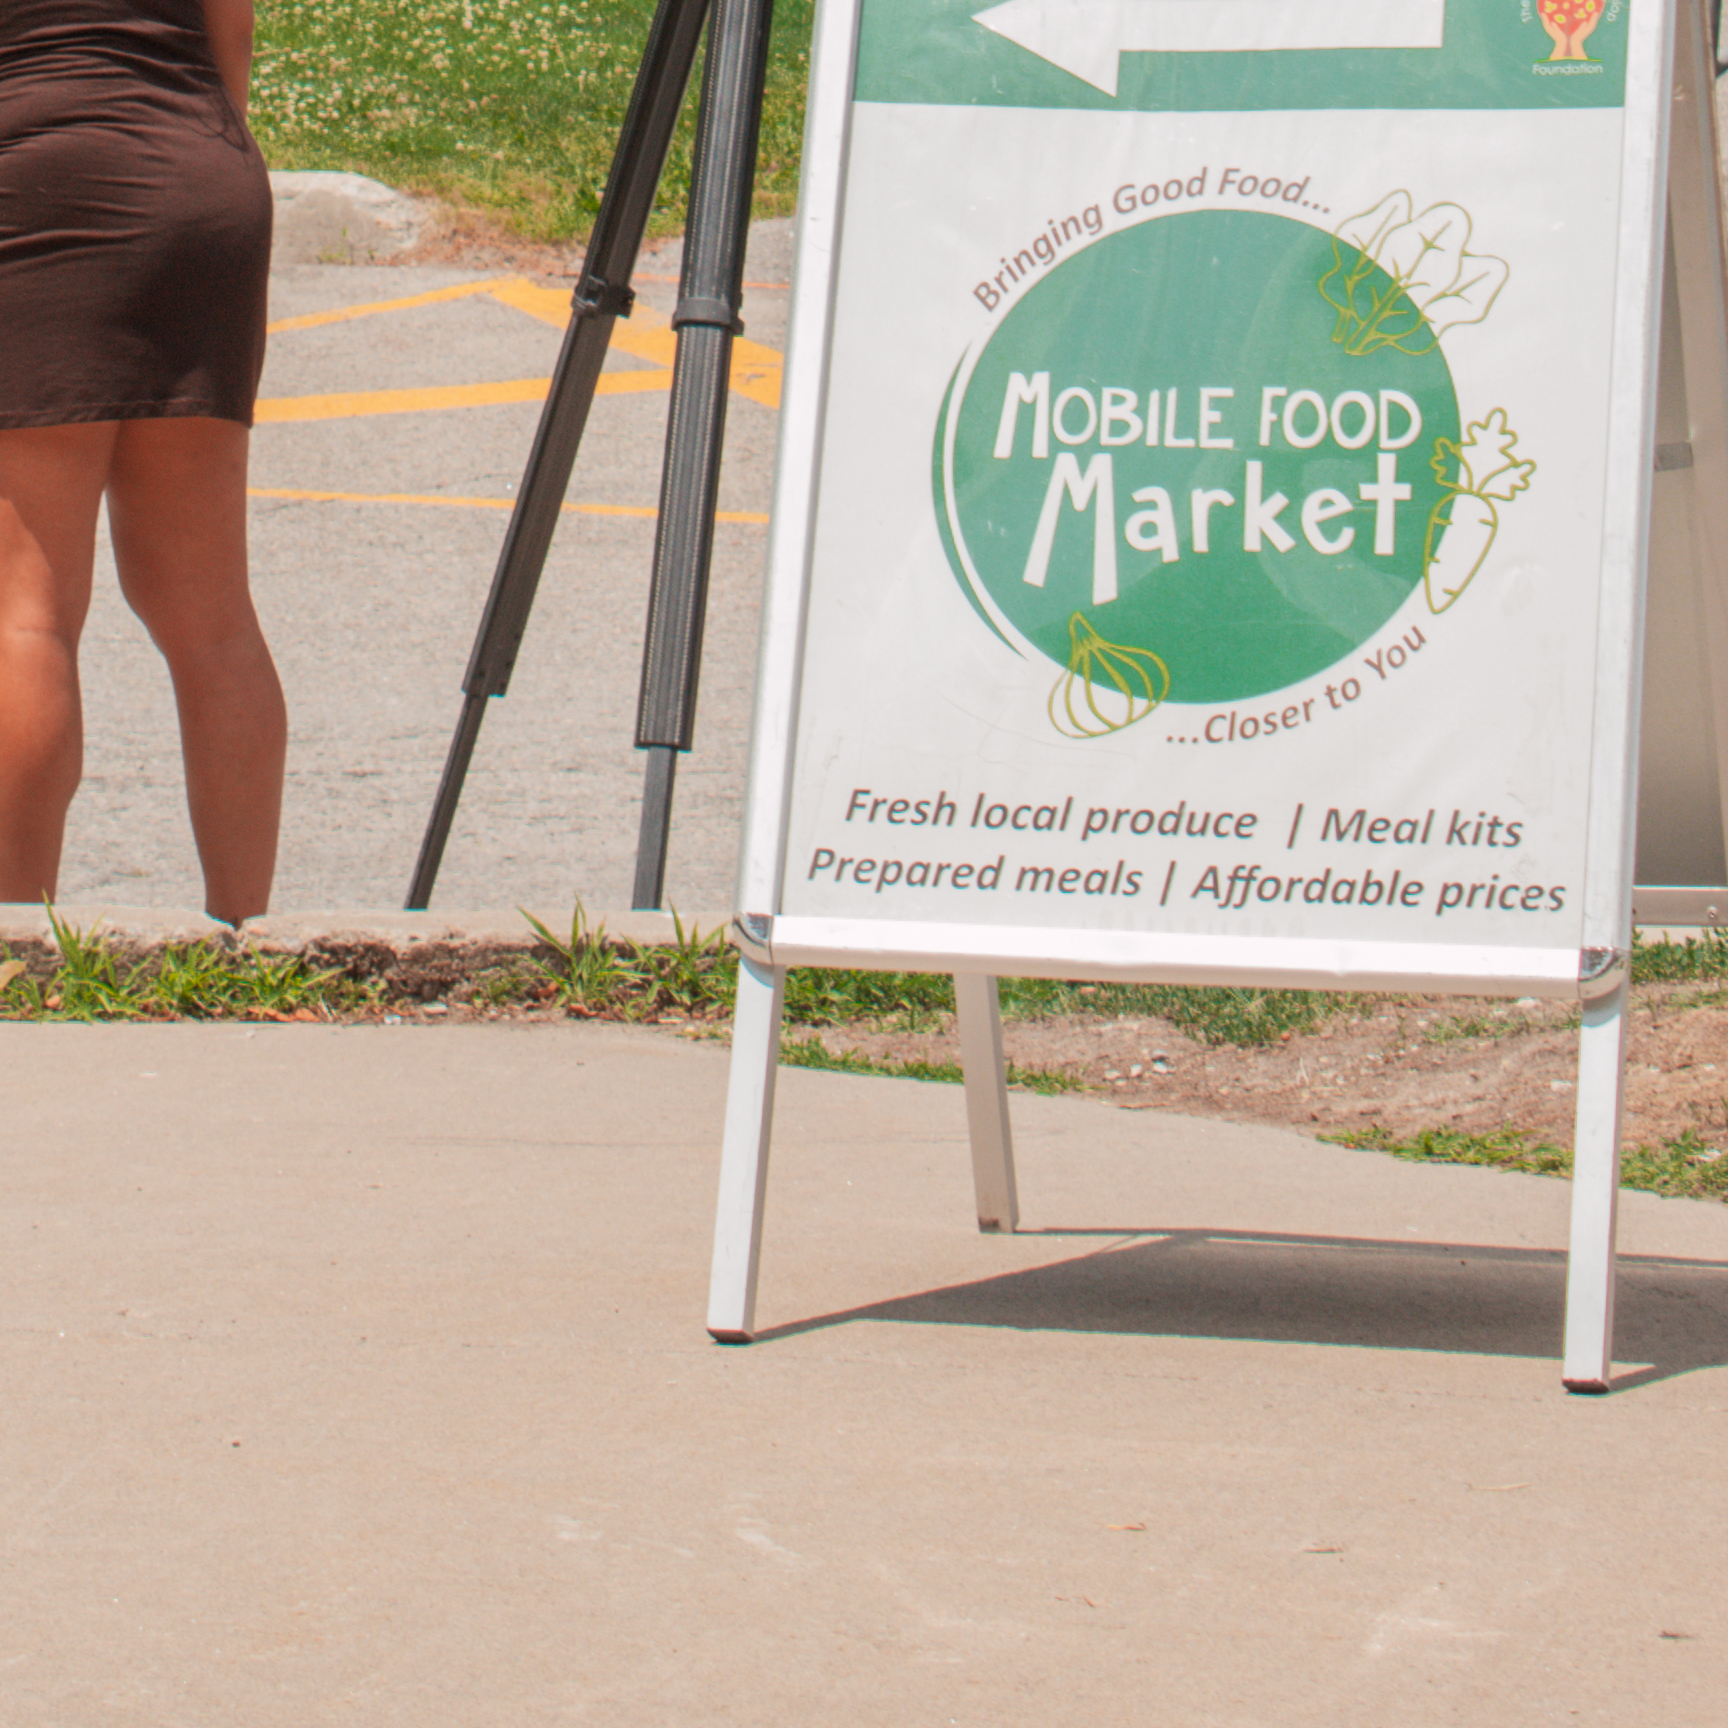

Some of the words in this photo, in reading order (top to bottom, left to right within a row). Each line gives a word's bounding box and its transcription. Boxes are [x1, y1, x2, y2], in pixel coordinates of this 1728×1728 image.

[1520, 0, 1533, 23] The
[1532, 63, 1603, 75] Foundation
[973, 203, 1104, 312] Bringing
[1112, 166, 1208, 215] Good
[1217, 167, 1331, 215] Food...
[993, 371, 1234, 459] MOBILE
[1259, 386, 1423, 450] FOOD
[1023, 452, 1412, 605] Market
[1166, 698, 1315, 743] ...Closer
[1324, 676, 1362, 710] to
[1364, 625, 1427, 680] You
[845, 789, 957, 827] Fresh
[970, 792, 1074, 832] local
[1081, 800, 1258, 841] produce
[1320, 808, 1435, 844] Meal
[1446, 809, 1525, 848] kits
[807, 848, 1005, 893] Prepared
[1015, 859, 1144, 896] meals
[1190, 865, 1425, 909] Affordable
[1436, 874, 1567, 916] prices
